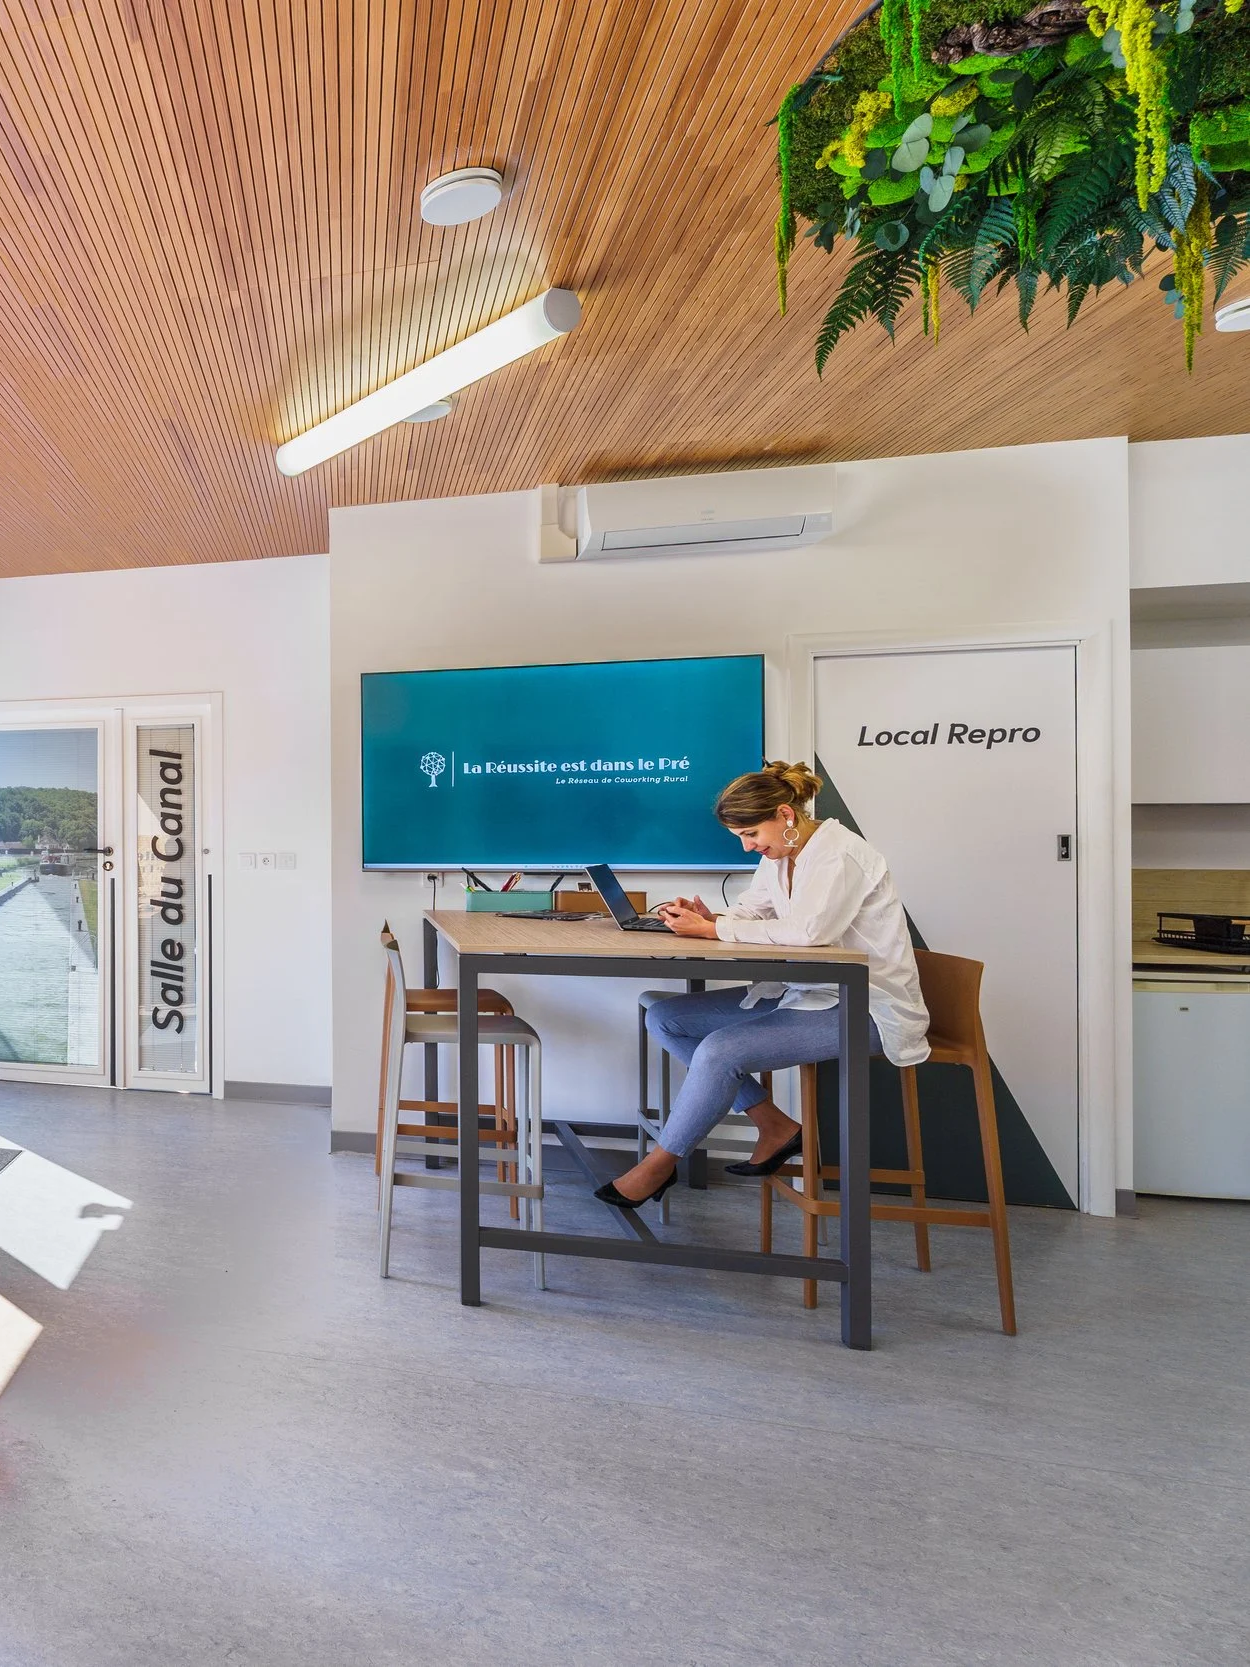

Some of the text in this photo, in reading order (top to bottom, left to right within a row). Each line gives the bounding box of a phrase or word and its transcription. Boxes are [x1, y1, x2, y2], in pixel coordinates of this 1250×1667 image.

[857, 723, 1041, 750] Local Repro
[463, 755, 690, 774] La Réussite est dans le Pré
[555, 775, 688, 785] Le Réseau de Coworking Rural
[149, 748, 184, 1034] Salle du Canal
